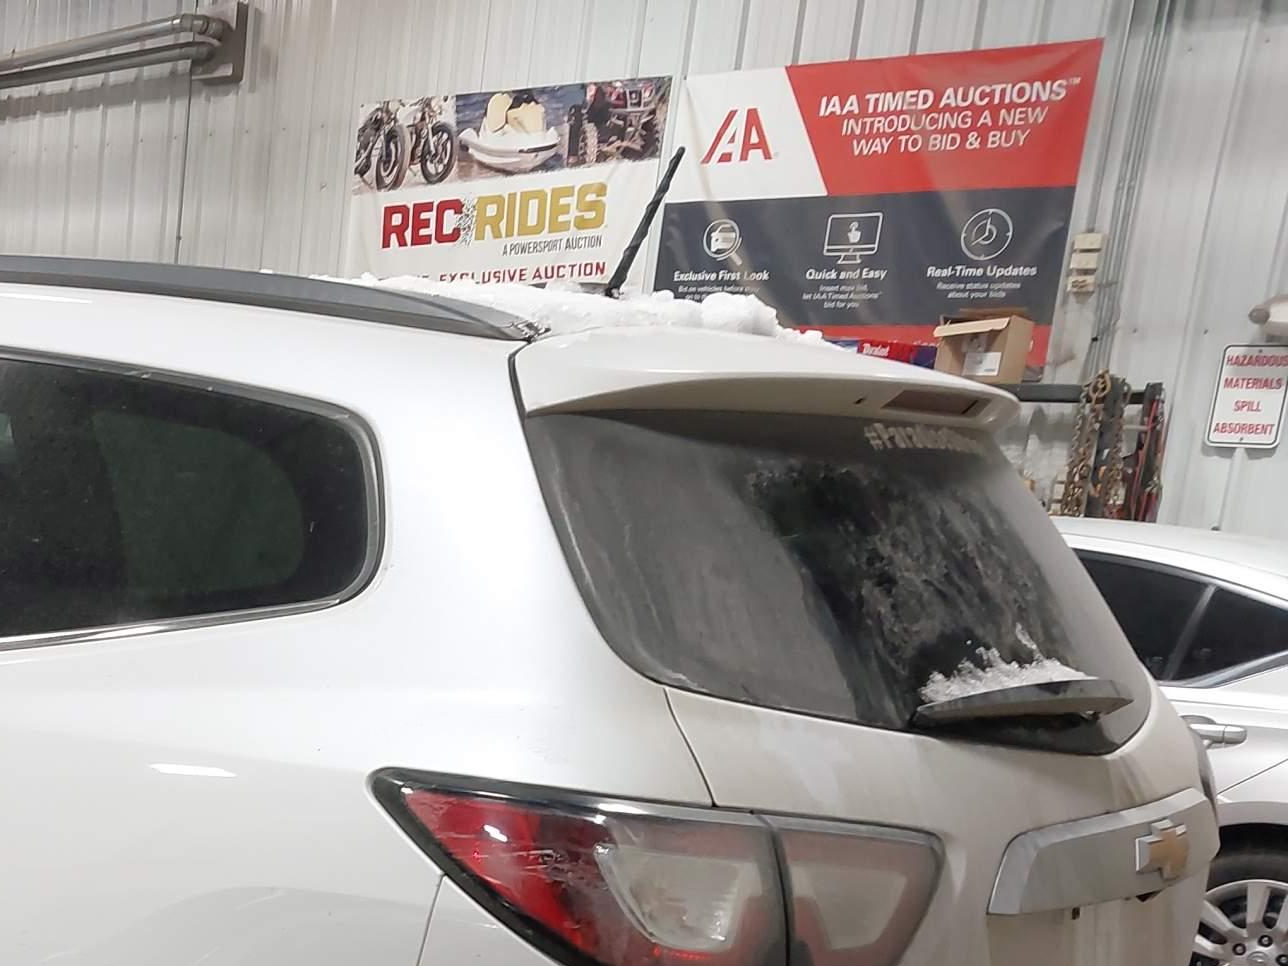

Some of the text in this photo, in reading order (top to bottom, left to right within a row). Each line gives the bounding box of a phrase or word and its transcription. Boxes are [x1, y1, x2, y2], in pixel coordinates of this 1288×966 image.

[819, 95, 859, 117] IAA
[865, 89, 934, 113] TIMED
[841, 107, 1049, 136] INTRODUCING A NEW
[852, 129, 1031, 155] WAY TO BID & BUY
[381, 182, 608, 249] REC RIDES
[502, 234, 602, 257] A POWERSPORT AUCTION
[531, 261, 606, 280] AUCTION
[673, 269, 769, 281] Exclusive First Look
[805, 267, 888, 281] Quick and Easy
[926, 264, 1038, 279] Real-Time Updates
[1225, 354, 1288, 367] HAZARDOUS
[1223, 377, 1283, 390] MATERIALS
[1234, 400, 1262, 412] SPILL
[1213, 422, 1275, 436] ABSORBENT
